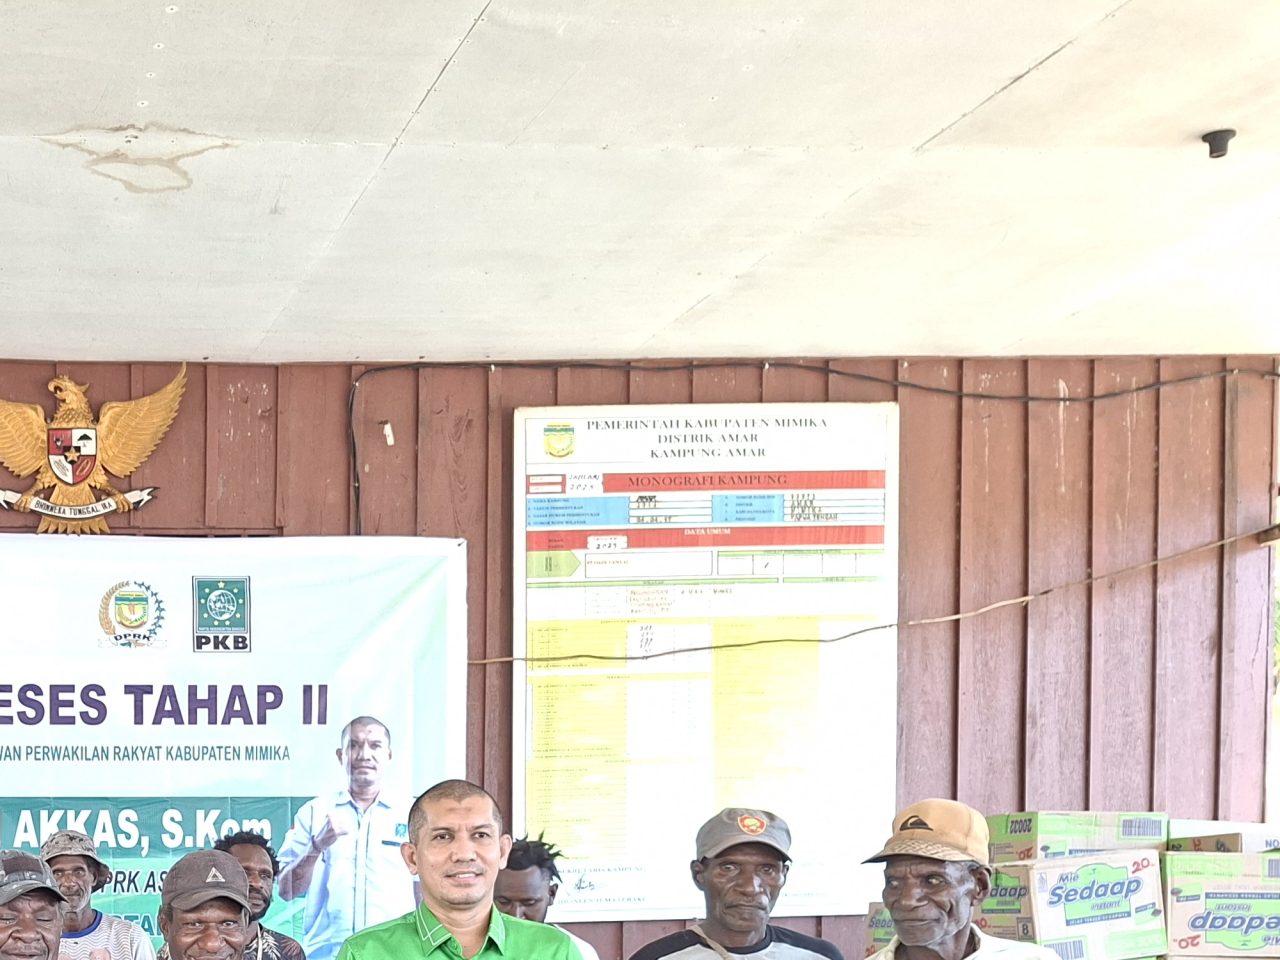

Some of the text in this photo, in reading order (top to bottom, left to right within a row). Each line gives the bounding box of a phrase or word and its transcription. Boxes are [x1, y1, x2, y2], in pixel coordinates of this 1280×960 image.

[587, 419, 680, 430] PEMERINTAH
[719, 433, 758, 443] AMAR
[726, 448, 765, 457] AMAR
[628, 475, 787, 488] MONOGRAFI KAMPUNG
[70, 506, 100, 516] TUNGGAL
[114, 633, 152, 642] DPRK
[196, 635, 249, 650] PKB
[124, 684, 284, 726] TAHAP
[302, 685, 329, 726] II
[25, 745, 108, 762] PERWAKILAN
[113, 746, 162, 762] RAKYAT
[166, 746, 241, 762] KABUPATEN
[245, 746, 291, 762] MIMIKA
[1058, 873, 1079, 883] Mie
[990, 886, 1028, 899] daap
[1049, 879, 1142, 906] Sedaap
[1190, 910, 1280, 935] edaap
